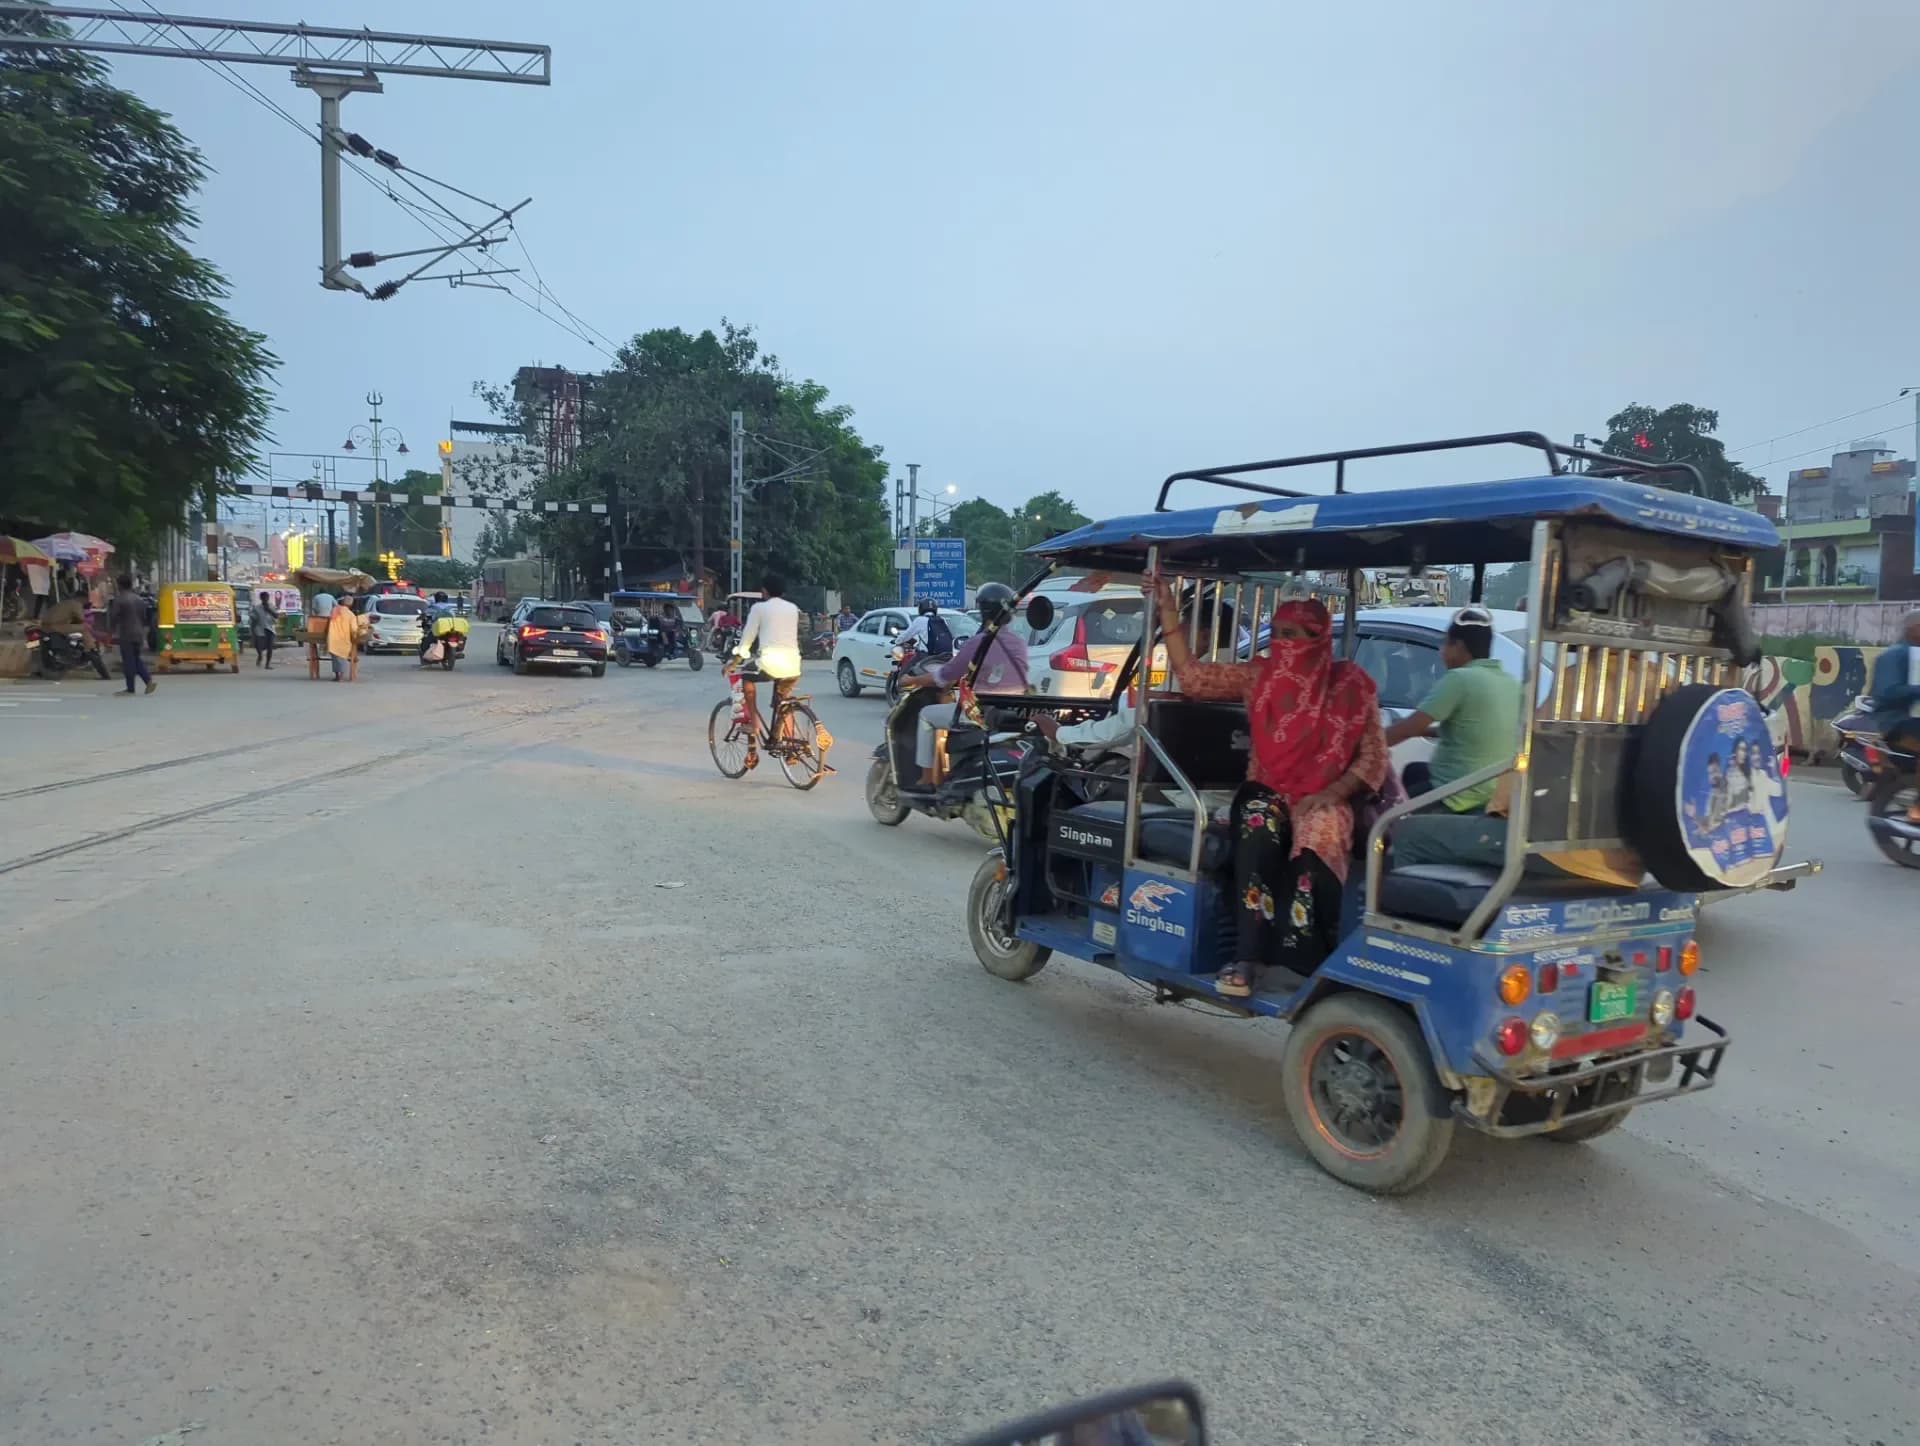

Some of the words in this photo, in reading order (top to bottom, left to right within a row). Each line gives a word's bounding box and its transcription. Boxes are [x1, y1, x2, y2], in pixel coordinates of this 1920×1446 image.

[930, 591, 954, 599] FAMILY
[1060, 826, 1112, 847] Singham
[1126, 909, 1185, 936] Singham
